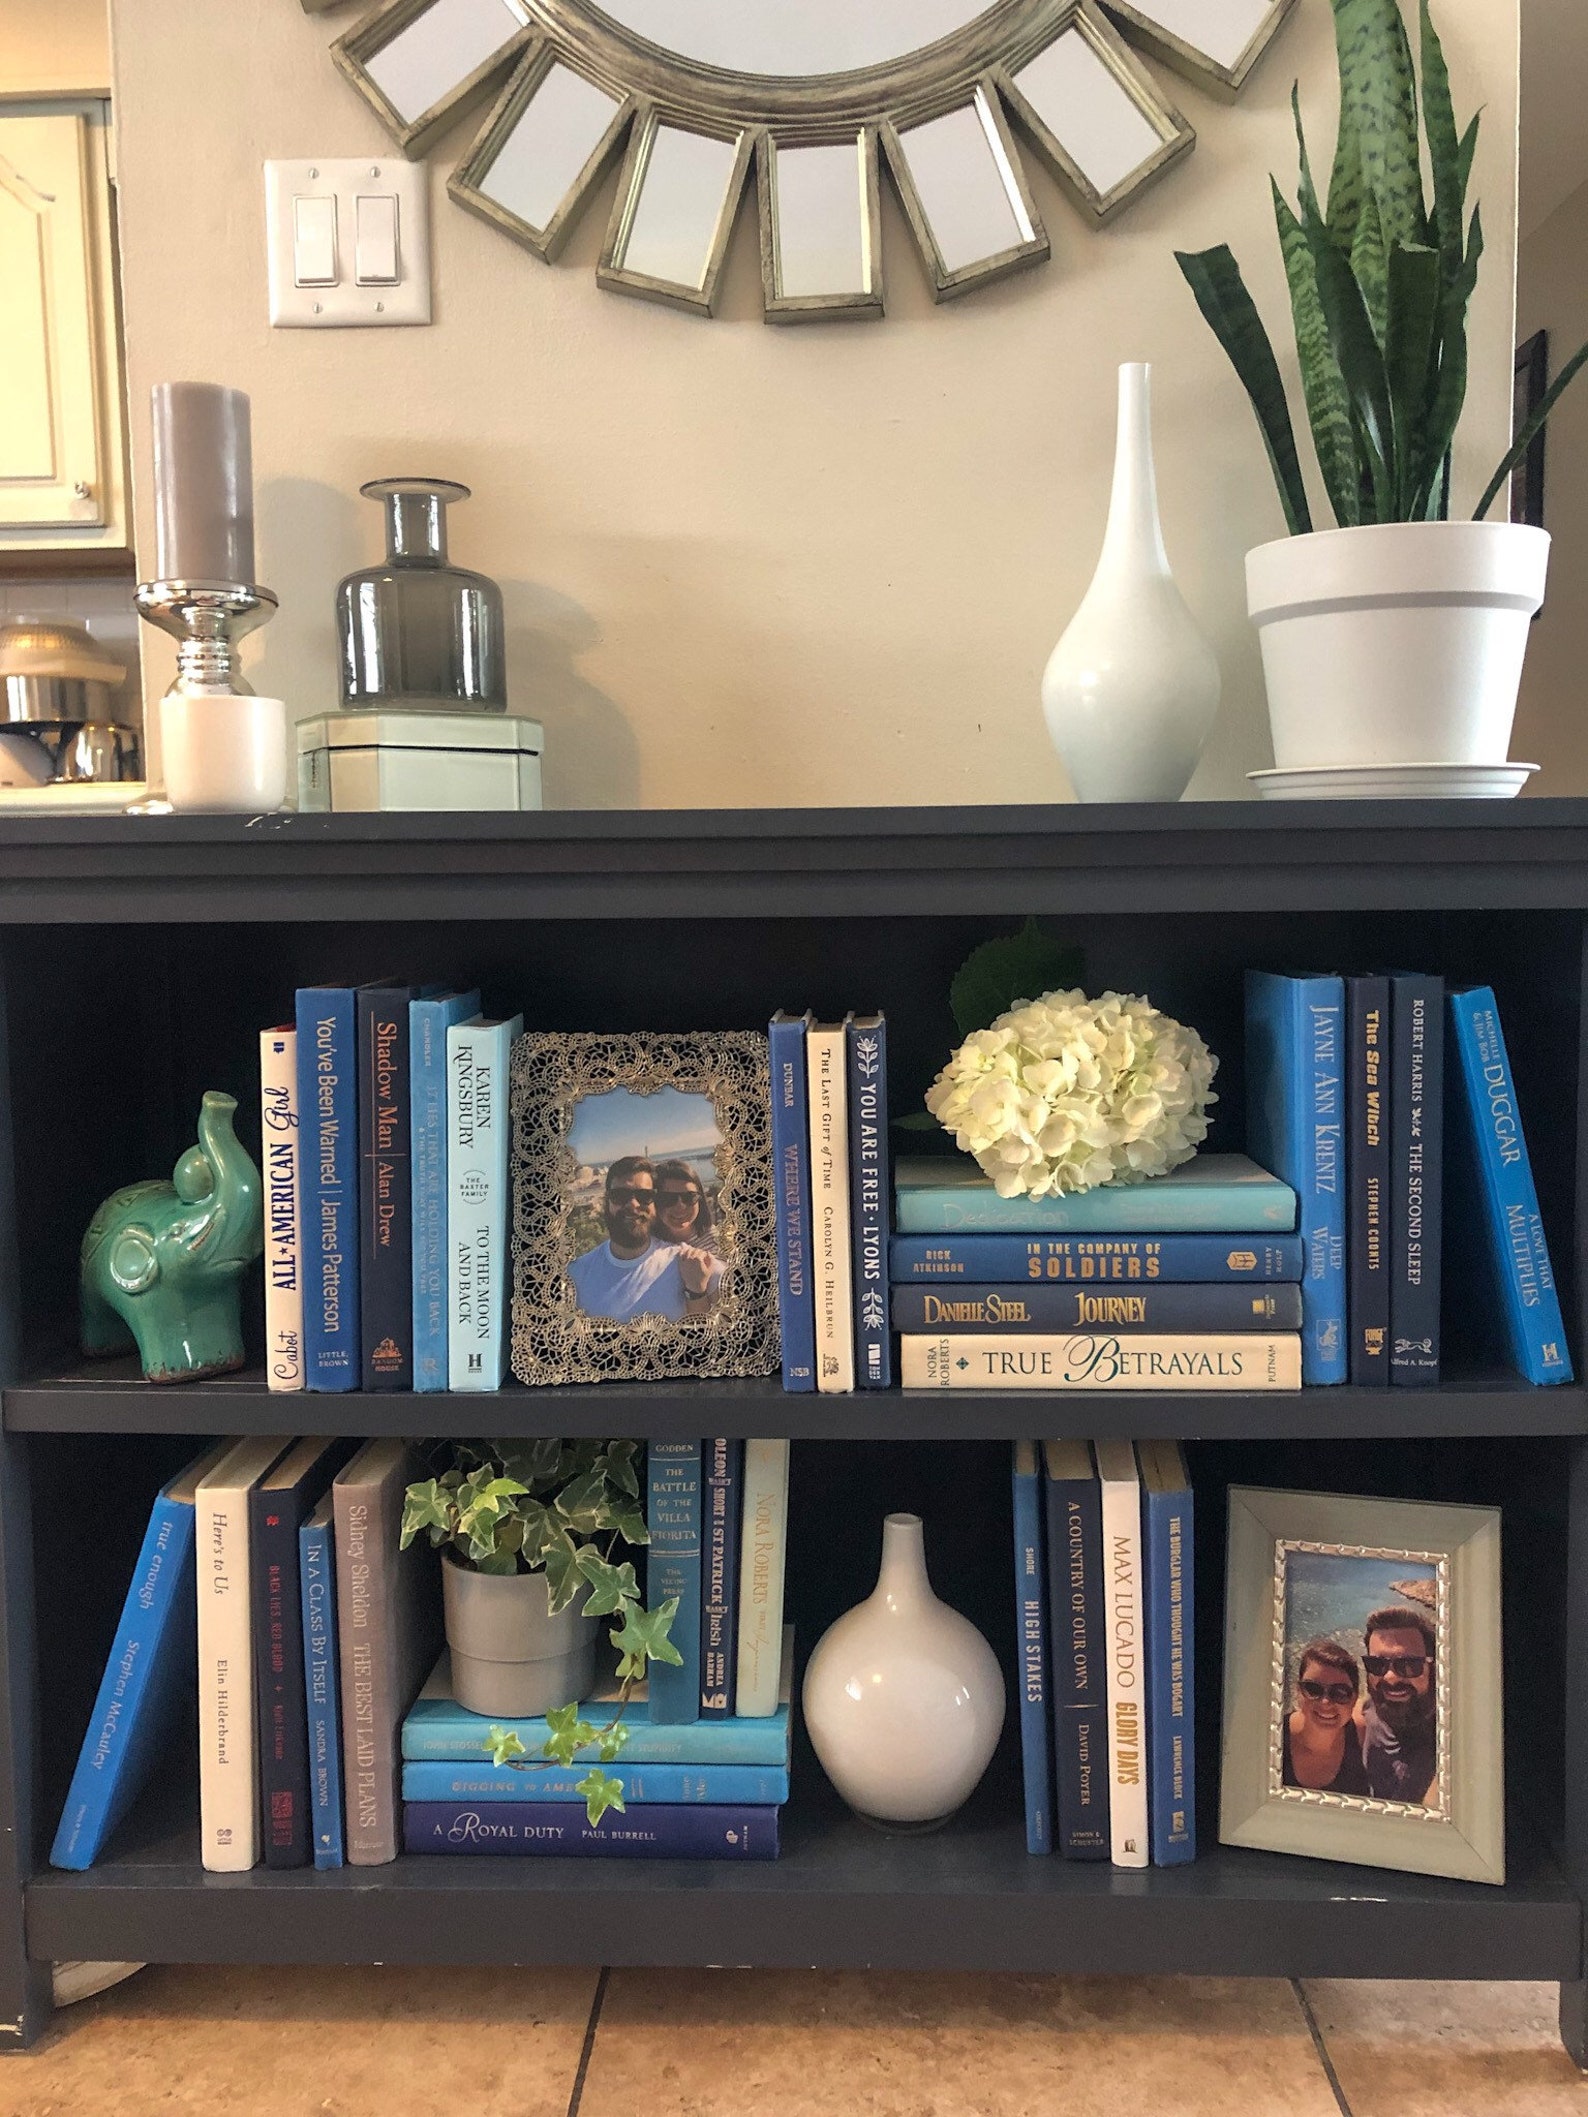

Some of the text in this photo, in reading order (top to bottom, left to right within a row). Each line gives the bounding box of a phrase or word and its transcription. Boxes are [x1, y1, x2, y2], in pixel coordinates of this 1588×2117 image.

[423, 1018, 432, 1067] CHANDLER
[820, 1048, 831, 1074] THE
[264, 1086, 299, 1132] Girl
[453, 1045, 473, 1150] KINGSBURY
[476, 1067, 491, 1129] KAREN
[820, 1079, 832, 1108] LAST
[1309, 1005, 1341, 1194] JAYNE ANN KRENTZ
[376, 1021, 398, 1247] Shadow Man Alan Drew
[427, 1102, 438, 1128] LIES
[821, 1113, 832, 1142] GIFT
[1484, 1064, 1521, 1168] DUGGAR
[427, 1133, 438, 1165] THAT
[820, 1146, 832, 1157] of
[1366, 1010, 1380, 1270] The Sea Witch STEPHEN COONTS
[1407, 998, 1425, 1286] ROBERT HARRIS THE SECOND SLEEP
[316, 1016, 342, 1333] You've Been Warned James Patterson
[461, 1190, 488, 1198] FAMILY
[783, 1063, 804, 1296] DUNBAR WHERE WE STAND
[822, 1159, 833, 1190] TIME
[860, 1083, 881, 1280] YOU ARE FREE LYONS
[428, 1199, 440, 1264] HOLDING
[823, 1206, 835, 1257] CAROLYN
[1027, 1243, 1161, 1254] IN THE COMPANY OF
[1531, 1225, 1545, 1254] LOVE
[913, 1263, 964, 1273] ATKINSON
[925, 1250, 951, 1260] RICK
[1028, 1257, 1161, 1279] SOLDIERS
[1311, 1226, 1329, 1280] WATERS
[1329, 1236, 1342, 1270] DEEP
[1505, 1204, 1541, 1308] MULTIPLIES
[1537, 1258, 1552, 1290] THAT
[429, 1268, 440, 1297] YOU
[458, 1242, 472, 1325] AND BACK
[476, 1225, 490, 1340] TO THE MOON
[429, 1300, 440, 1337] BACK
[825, 1280, 837, 1339] HEILBRUN
[923, 1294, 1032, 1324] DANIELLE STEEL
[1072, 1291, 1147, 1327] JOURNEY
[274, 1329, 299, 1380] Cabot
[926, 1346, 938, 1378] NORA
[940, 1338, 950, 1386] ROBERTS
[982, 1335, 1244, 1383] TRUE BETRAYALS
[1267, 1344, 1277, 1383] PUTNAM
[655, 1444, 694, 1453] GODDEN
[652, 1481, 697, 1492] BATTLE
[665, 1468, 684, 1476] THE
[656, 1498, 692, 1507] OF THE
[657, 1512, 691, 1523] VILLA
[713, 1487, 726, 1517] SHORT
[347, 1505, 366, 1558] Sidney
[651, 1530, 697, 1541] FIORITA
[1169, 1516, 1181, 1535] THE
[138, 1521, 174, 1610] true enough
[212, 1512, 229, 1595] Here's to Us
[753, 1493, 776, 1605] NORA ROBERTS
[1170, 1536, 1181, 1578] BURGLAR
[711, 1546, 725, 1604] PATRICK
[1170, 1579, 1182, 1602] WHO
[352, 1565, 369, 1628] Sheldon
[1024, 1546, 1042, 1702] SHORE HIGH STAKES
[1171, 1603, 1182, 1646] THOUGHT
[353, 1644, 370, 1677] THE
[715, 1652, 725, 1687] ANDREA
[1068, 1501, 1092, 1806] A COUNTRY OF OUR OWN DAVID POYER
[1113, 1535, 1139, 1785] MAX LUCADO GLORY DAYS
[1171, 1647, 1182, 1660] HE
[1171, 1660, 1182, 1681] WAS
[307, 1544, 328, 1807] IN A CLASS BY ITSELF SANDRA BROWN
[92, 1639, 140, 1771] Stephen McCauley
[217, 1659, 229, 1765] Elin Hilderbrand
[355, 1681, 372, 1725] BEST
[1171, 1681, 1183, 1717] BOGART
[356, 1729, 374, 1767] LAID
[358, 1772, 377, 1828] PLANS
[433, 1812, 656, 1843] A ROYAL DUTY PAUL BURRELL
